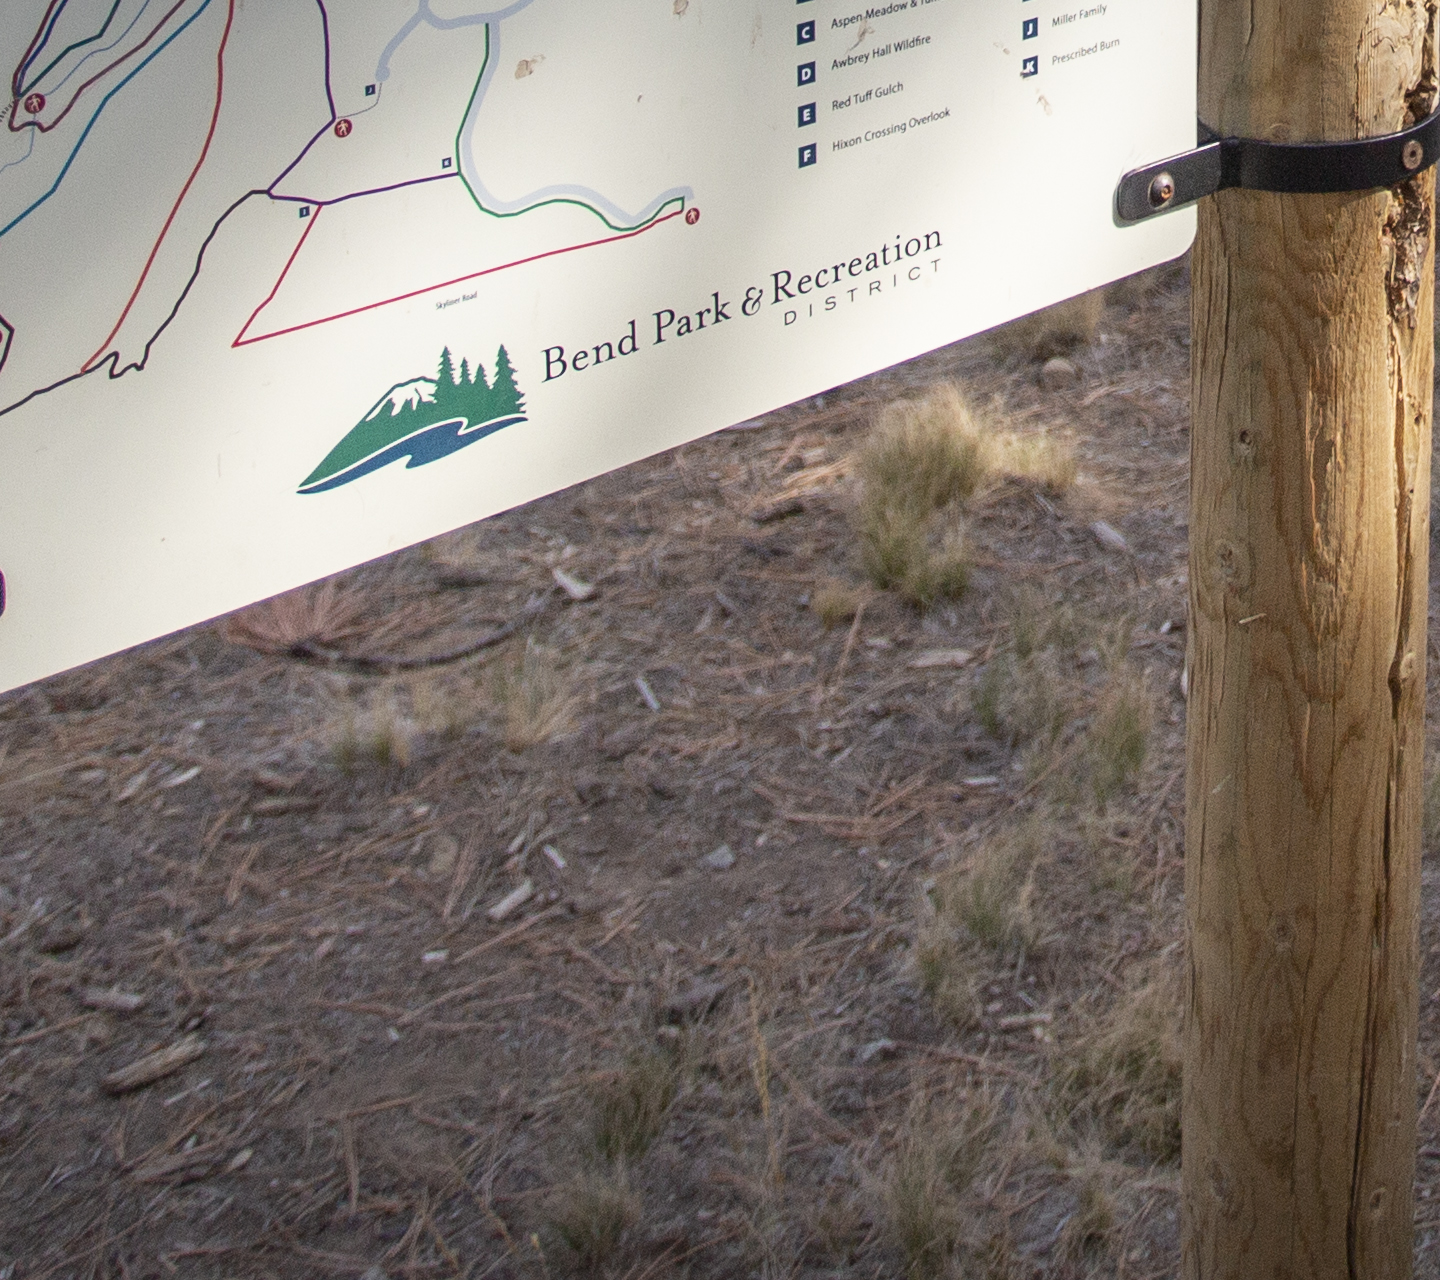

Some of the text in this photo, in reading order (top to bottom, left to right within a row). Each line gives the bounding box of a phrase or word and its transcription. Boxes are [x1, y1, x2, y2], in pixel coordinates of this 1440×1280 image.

[832, 36, 930, 69] Awbrey Hall Wildfire
[832, 82, 903, 110] Red Tuff Gulch
[833, 108, 950, 151] Hixon Crossing Overlook
[544, 231, 941, 381] Bend Park & Recreation
[784, 258, 943, 326] DISTRICT
